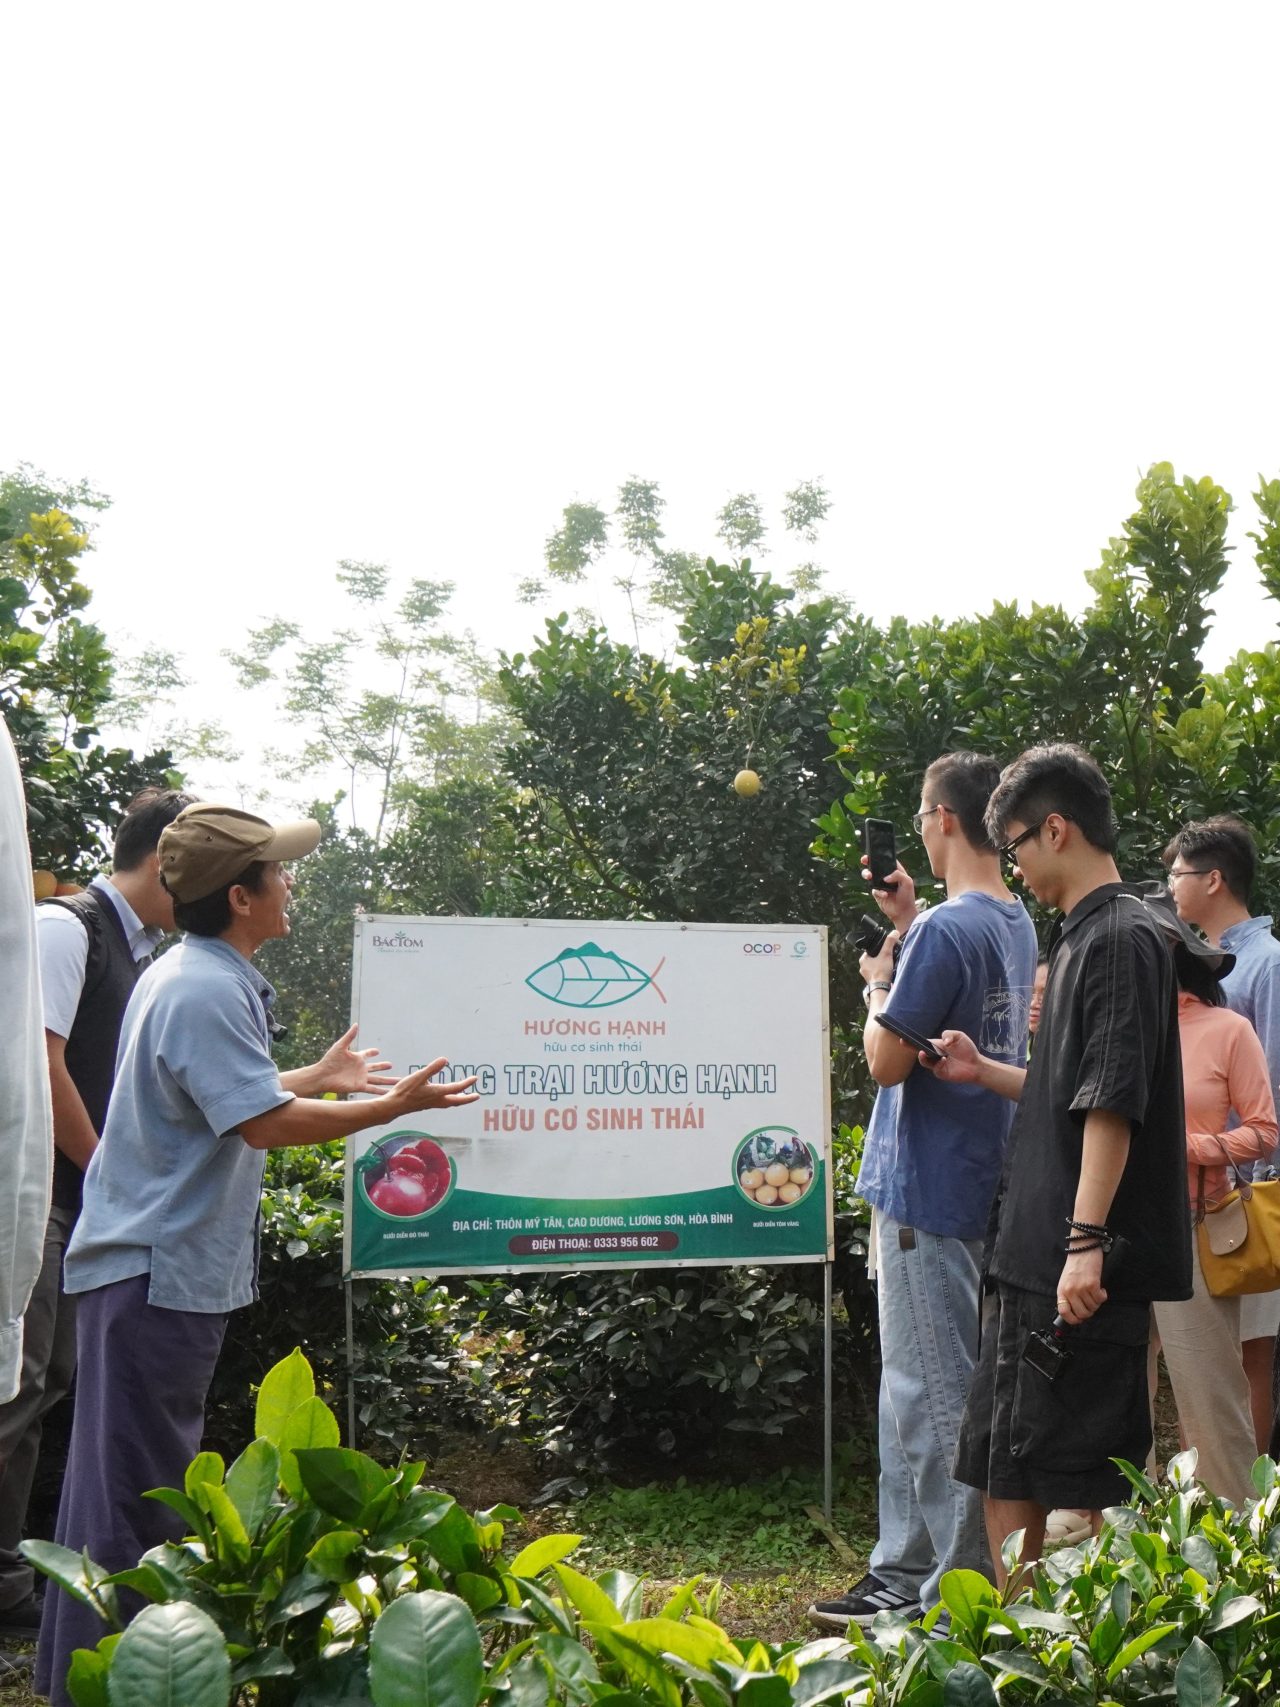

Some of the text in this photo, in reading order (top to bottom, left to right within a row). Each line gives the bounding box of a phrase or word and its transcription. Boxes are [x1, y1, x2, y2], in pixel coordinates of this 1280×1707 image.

[743, 943, 781, 954] OCOP
[524, 1019, 666, 1039] HƯƠNG HẠNH
[544, 1041, 642, 1052] hữu cơ sinh thái
[504, 1064, 574, 1101] TRẠI
[584, 1061, 688, 1094] HƯƠNG
[696, 1064, 776, 1100] HẠNH
[484, 1102, 705, 1131] HỮU CƠ SINH THÁI
[452, 1220, 470, 1232] ĐỊA
[472, 1217, 492, 1230] CHỈ:
[495, 1217, 522, 1230] THÔN
[525, 1216, 541, 1229] MỸ
[543, 1216, 565, 1229] TÂN,
[567, 1217, 587, 1228] CAO
[629, 1214, 661, 1226] LƯƠNG
[664, 1213, 687, 1226] SƠN,
[689, 1212, 708, 1224] HÒA
[711, 1212, 733, 1224] BÌNH
[532, 1236, 659, 1252] ĐIỆN THOẠI: 0333 956 602
